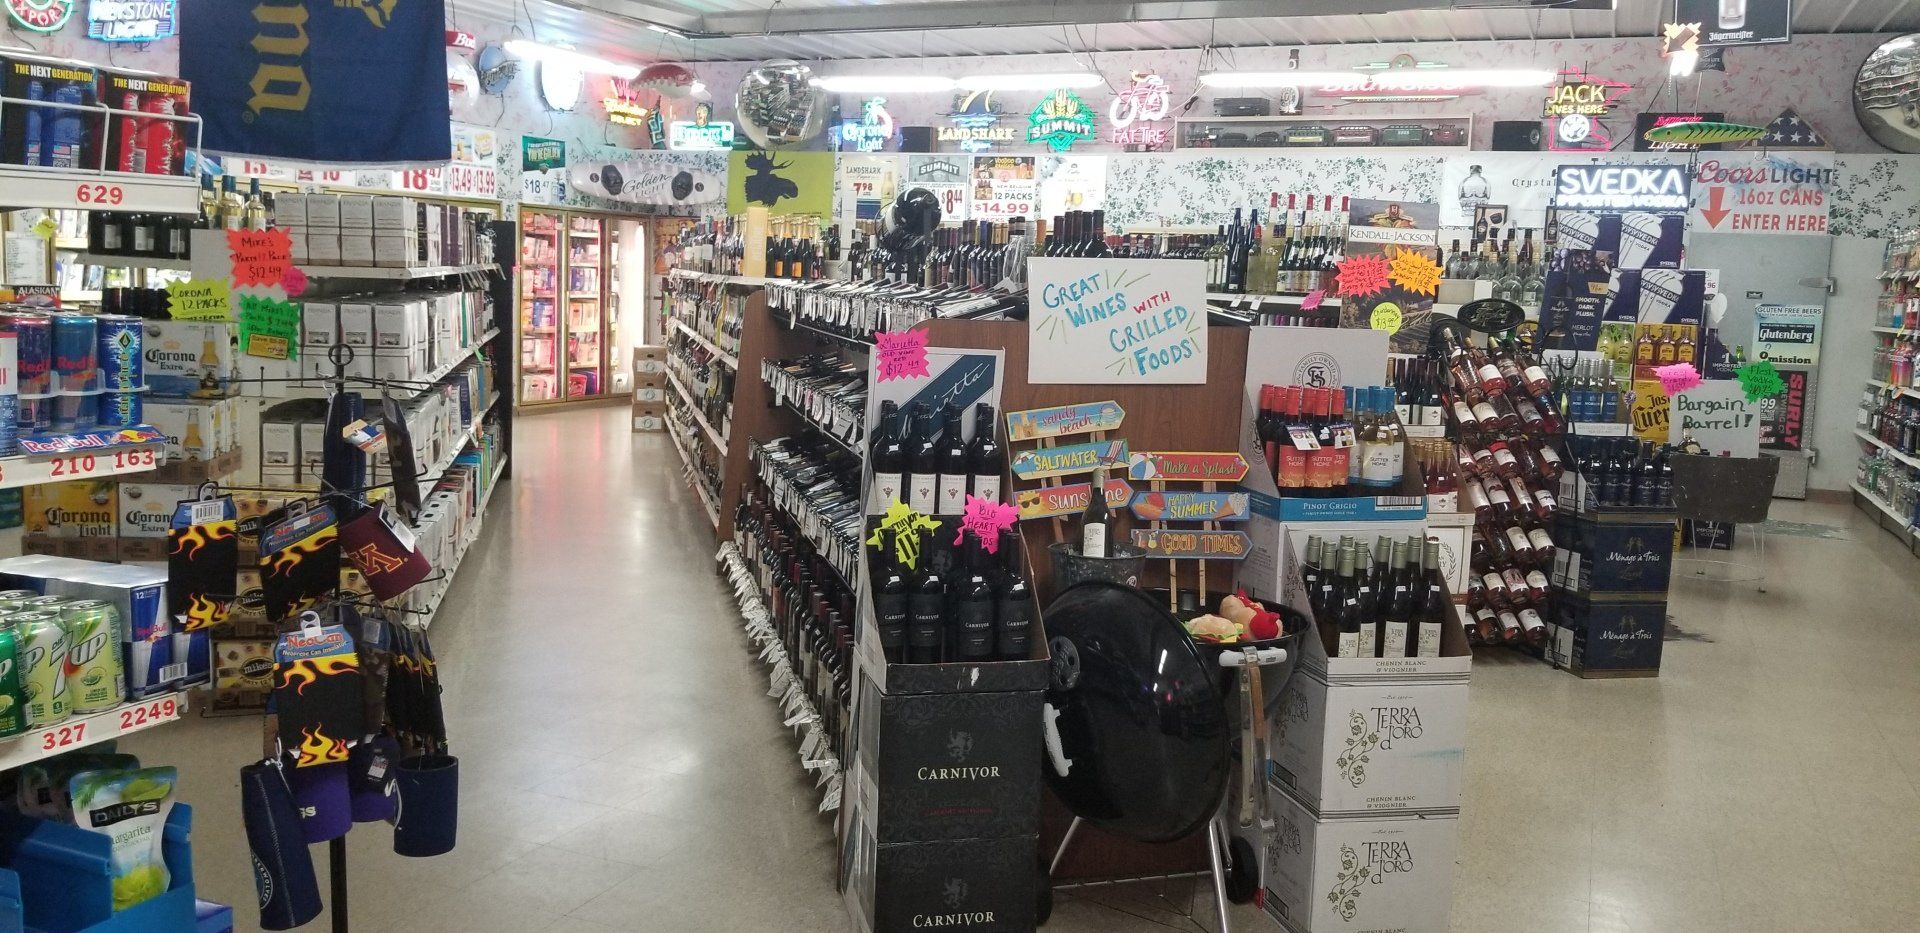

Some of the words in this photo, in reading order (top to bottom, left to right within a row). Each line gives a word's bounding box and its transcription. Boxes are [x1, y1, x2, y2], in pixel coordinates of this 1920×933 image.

[1709, 31, 1754, 42] Jägermeister
[14, 63, 30, 75] THE
[30, 65, 51, 79] NEXT
[52, 69, 94, 83] GENERATION
[113, 78, 128, 88] THE
[128, 80, 148, 92] NEXT
[147, 82, 188, 95] GENERATION
[1547, 84, 1606, 104] JACK
[843, 122, 892, 140] Corona
[938, 126, 1014, 142] LANDSHARK
[1033, 120, 1091, 138] SUMMIT
[1112, 128, 1137, 144] FAT
[1137, 127, 1165, 144] TIRE
[857, 135, 883, 151] Light
[846, 166, 881, 175] LANDSHARK
[920, 161, 959, 174] SUMMIT
[1698, 160, 1767, 184] Coors
[1770, 168, 1833, 184] LIGHT
[622, 172, 673, 195] Golden
[1559, 168, 1684, 195] SVEDKA
[77, 186, 123, 204] 629
[995, 192, 1002, 200] 12
[1005, 192, 1033, 200] PACKS
[1780, 188, 1823, 206] CANS
[975, 202, 1029, 213] $14.99
[1733, 214, 1780, 230] ENTER
[1787, 214, 1827, 231] HERE
[1350, 228, 1435, 243] KENDALL-JACKSON
[17, 285, 59, 296] ALASKAN
[171, 287, 213, 299] CORONA
[1043, 272, 1101, 308] GREAT
[182, 299, 194, 310] 12
[196, 298, 227, 309] PACKS
[1065, 292, 1128, 328] WINES
[1132, 290, 1171, 314] WITH
[1109, 305, 1188, 352] GRILLED
[1759, 328, 1813, 343] Glutenberg
[145, 348, 196, 364] Corona
[1133, 338, 1193, 376] FOODS
[1759, 351, 1812, 364] Omission
[160, 363, 184, 371] Extra
[1677, 394, 1746, 415] Bargain
[1785, 373, 1804, 448] SURLY
[1041, 406, 1078, 428] sandy
[1682, 413, 1754, 430] Barrel!
[1059, 417, 1093, 435] beach
[23, 440, 68, 453] Red
[51, 454, 96, 476] 210
[115, 449, 155, 469] 163
[1033, 449, 1098, 472] SALTWATER
[1162, 459, 1191, 474] Make
[1192, 465, 1199, 474] a
[1202, 459, 1239, 477] Splash
[1167, 492, 1197, 507] HAPPY
[1303, 502, 1327, 510] PINOT
[1329, 501, 1358, 510] GRIGIO
[45, 507, 111, 527] Corona
[979, 504, 997, 518] BIG
[1170, 500, 1218, 519] SUMMER
[77, 524, 111, 538] Light
[141, 524, 165, 532] Extra
[967, 518, 1003, 532] HEARTY
[1161, 533, 1196, 552] GOOD
[1201, 533, 1243, 554] TIMES
[1606, 551, 1637, 564] Ménage
[1643, 551, 1660, 562] Trois
[135, 591, 144, 599] 12
[152, 624, 168, 633] Bull
[1600, 630, 1631, 643] Ménage
[1636, 630, 1652, 640] Trois
[282, 648, 309, 658] Neoprene
[310, 648, 322, 657] Can
[120, 699, 176, 730] 2249
[1371, 706, 1421, 732] TERRA
[42, 723, 86, 751] 327
[918, 766, 1001, 781] CARNIVOR
[93, 801, 158, 824] DAILY'S
[1362, 840, 1412, 867] TERRA
[913, 911, 996, 928] CARNIVOR
